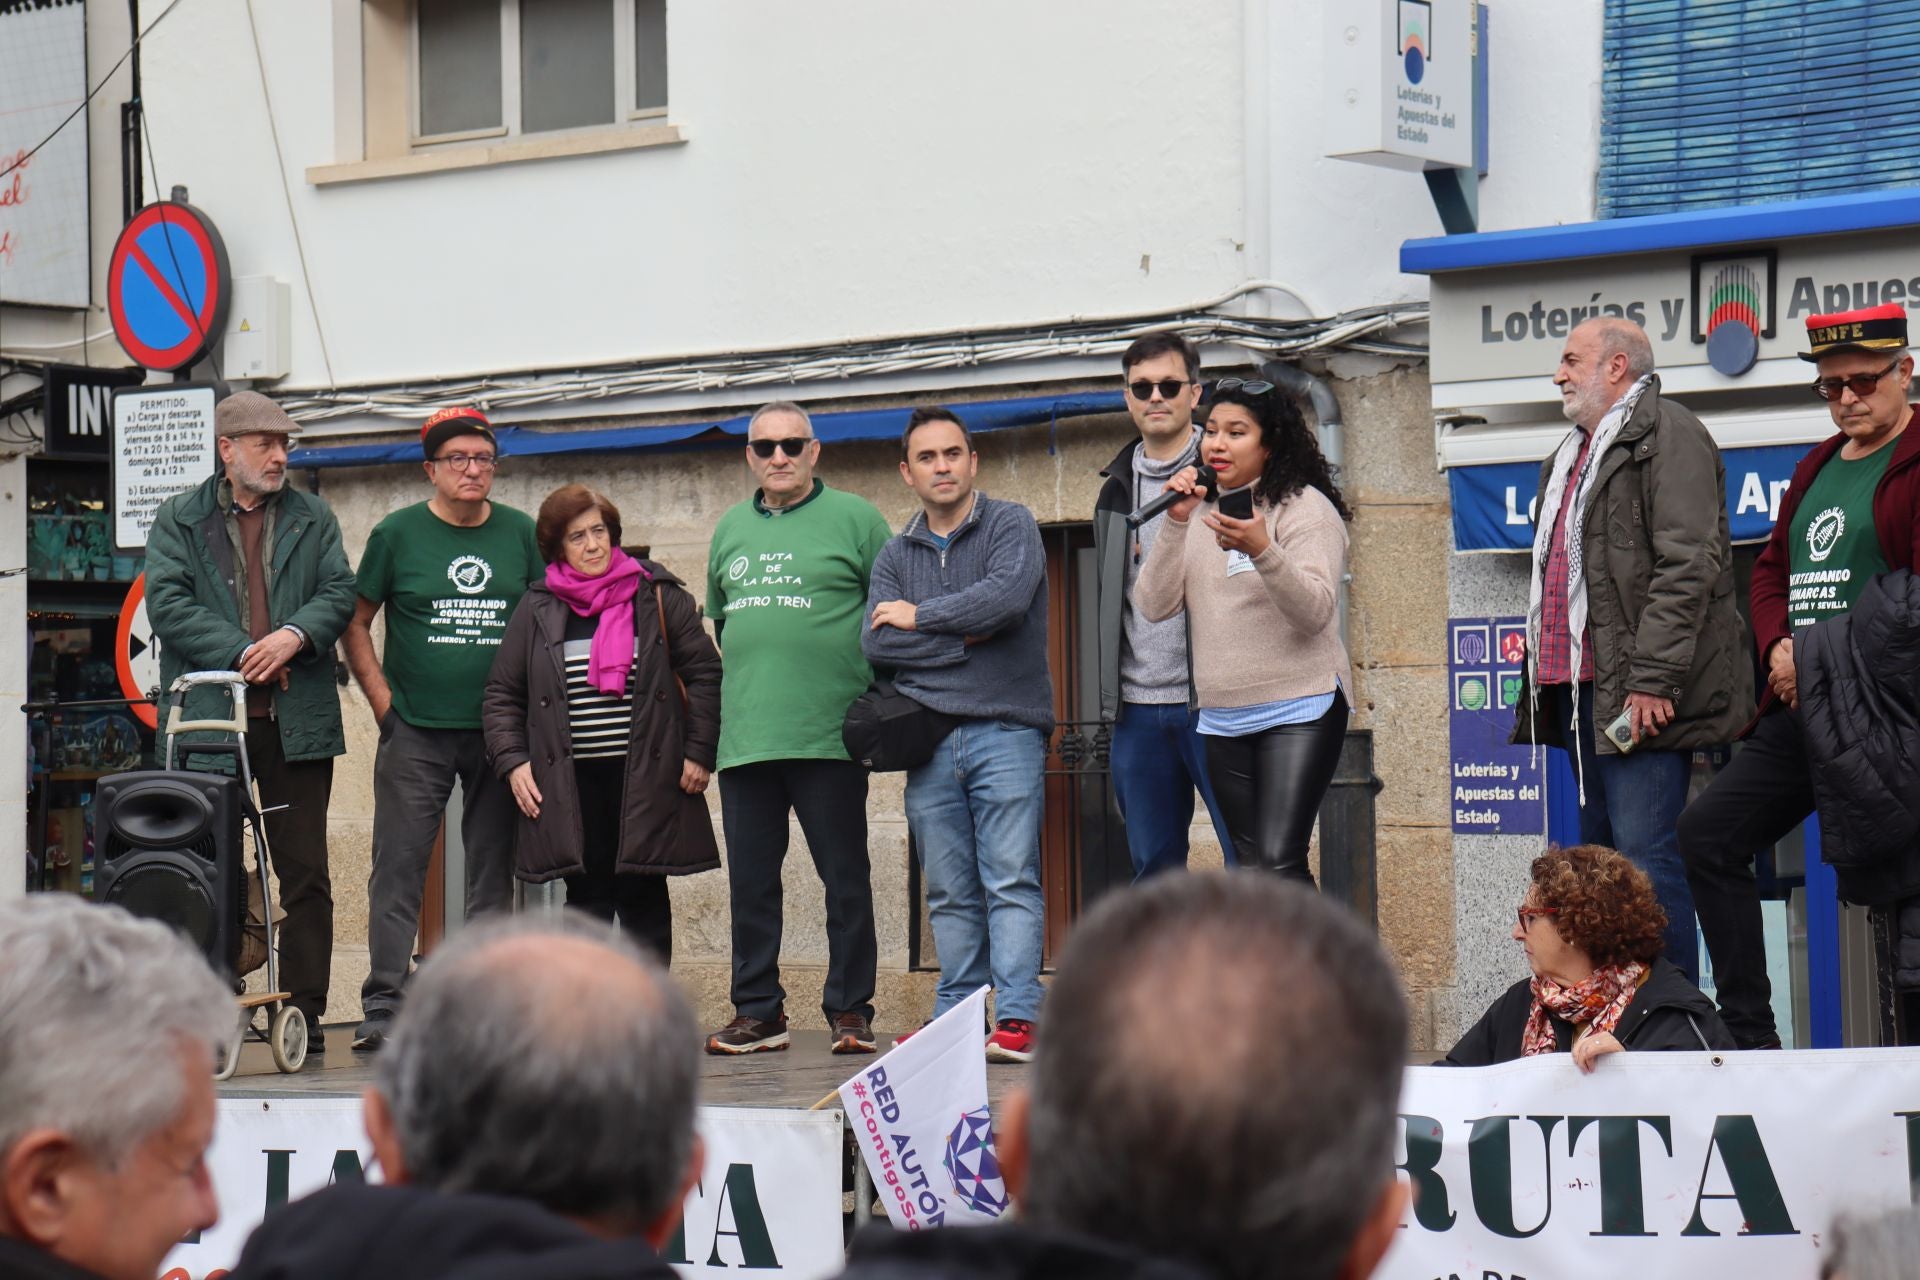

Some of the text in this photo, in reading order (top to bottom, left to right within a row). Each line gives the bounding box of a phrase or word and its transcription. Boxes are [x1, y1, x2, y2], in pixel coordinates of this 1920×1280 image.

[1397, 85, 1441, 110] Loterías y
[1398, 105, 1455, 129] Apuestas del
[1397, 125, 1429, 143] Estado
[1660, 298, 1685, 341] y
[1809, 323, 1863, 343] RENFE
[140, 398, 189, 410] PERMITIDO:
[137, 411, 160, 424] Carga
[168, 409, 201, 420] descarga
[124, 422, 164, 436] profesional
[166, 422, 176, 431] de
[178, 420, 198, 430] lunes
[126, 434, 151, 444] viernes
[154, 433, 163, 442] de
[165, 432, 170, 441] 8
[191, 432, 196, 440] h
[199, 432, 203, 441] y
[123, 447, 132, 456] de
[134, 445, 142, 454] 17
[151, 444, 162, 454] 20
[128, 454, 200, 467] domingos y festivos
[143, 467, 152, 477] de
[154, 467, 159, 476] 8
[168, 465, 177, 475] 12
[180, 466, 185, 474] h
[121, 509, 143, 518] centro
[144, 510, 148, 518] y
[760, 553, 793, 561] RUTA
[766, 564, 782, 573] DE
[743, 576, 802, 586] LA PLATA
[432, 599, 507, 610] VERTEBRANDO
[776, 596, 811, 609] TREN
[1810, 602, 1815, 610] Y
[1817, 600, 1848, 610] SEVILLA
[440, 609, 496, 619] COMARCAS
[430, 617, 451, 625] ENTRE
[427, 635, 467, 644] PLASENCIA
[1454, 762, 1520, 780] Loterías y
[1455, 785, 1540, 803] Apuestas del
[1455, 809, 1500, 824] Estado
[866, 1065, 900, 1124] RED
[1394, 1113, 1801, 1240] RUTA
